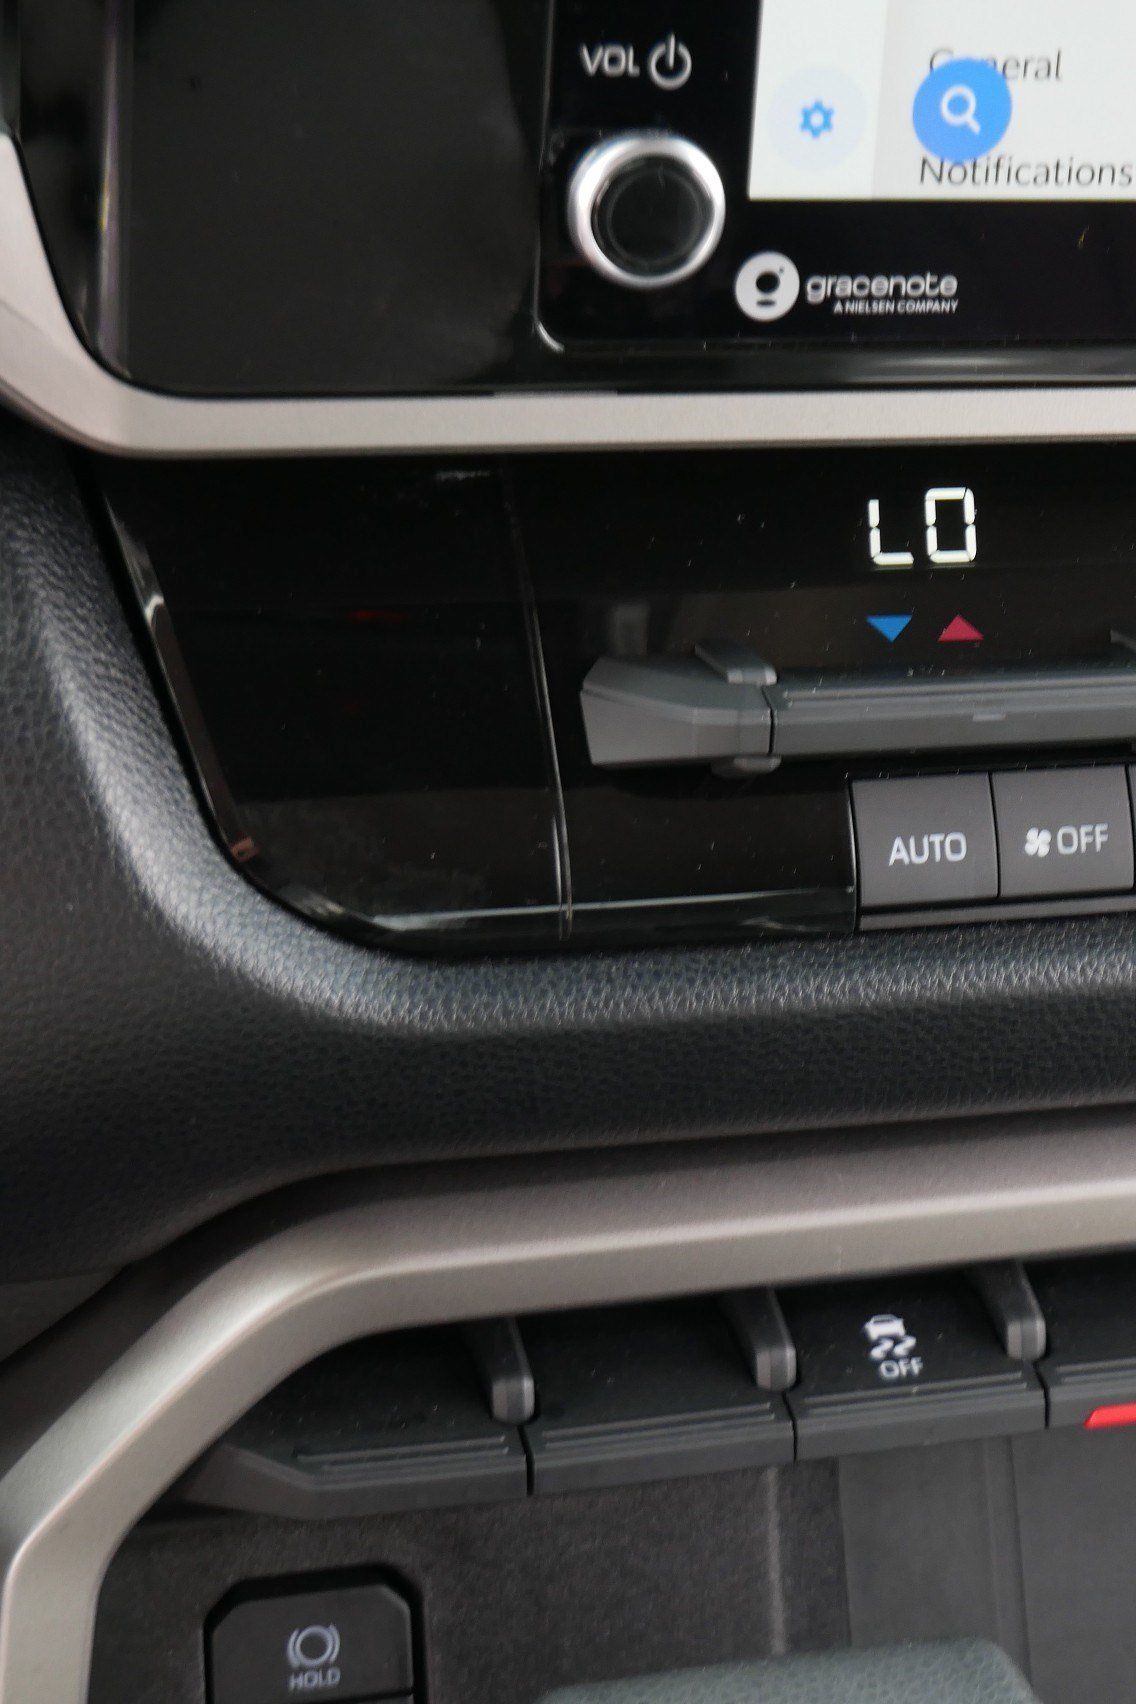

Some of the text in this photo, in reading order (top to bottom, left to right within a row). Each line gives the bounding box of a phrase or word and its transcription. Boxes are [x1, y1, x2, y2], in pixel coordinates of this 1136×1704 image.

[581, 43, 640, 77] VOL
[929, 48, 1062, 80] Geral
[920, 154, 1134, 187] Notifications
[807, 272, 958, 304] gracenote
[833, 299, 959, 315] A NIELSEN COMPANY
[868, 487, 977, 566] LO
[888, 832, 967, 866] AUTO
[1056, 823, 1109, 855] OFF
[879, 1356, 923, 1379] OFF
[288, 1667, 341, 1691] HOLD
